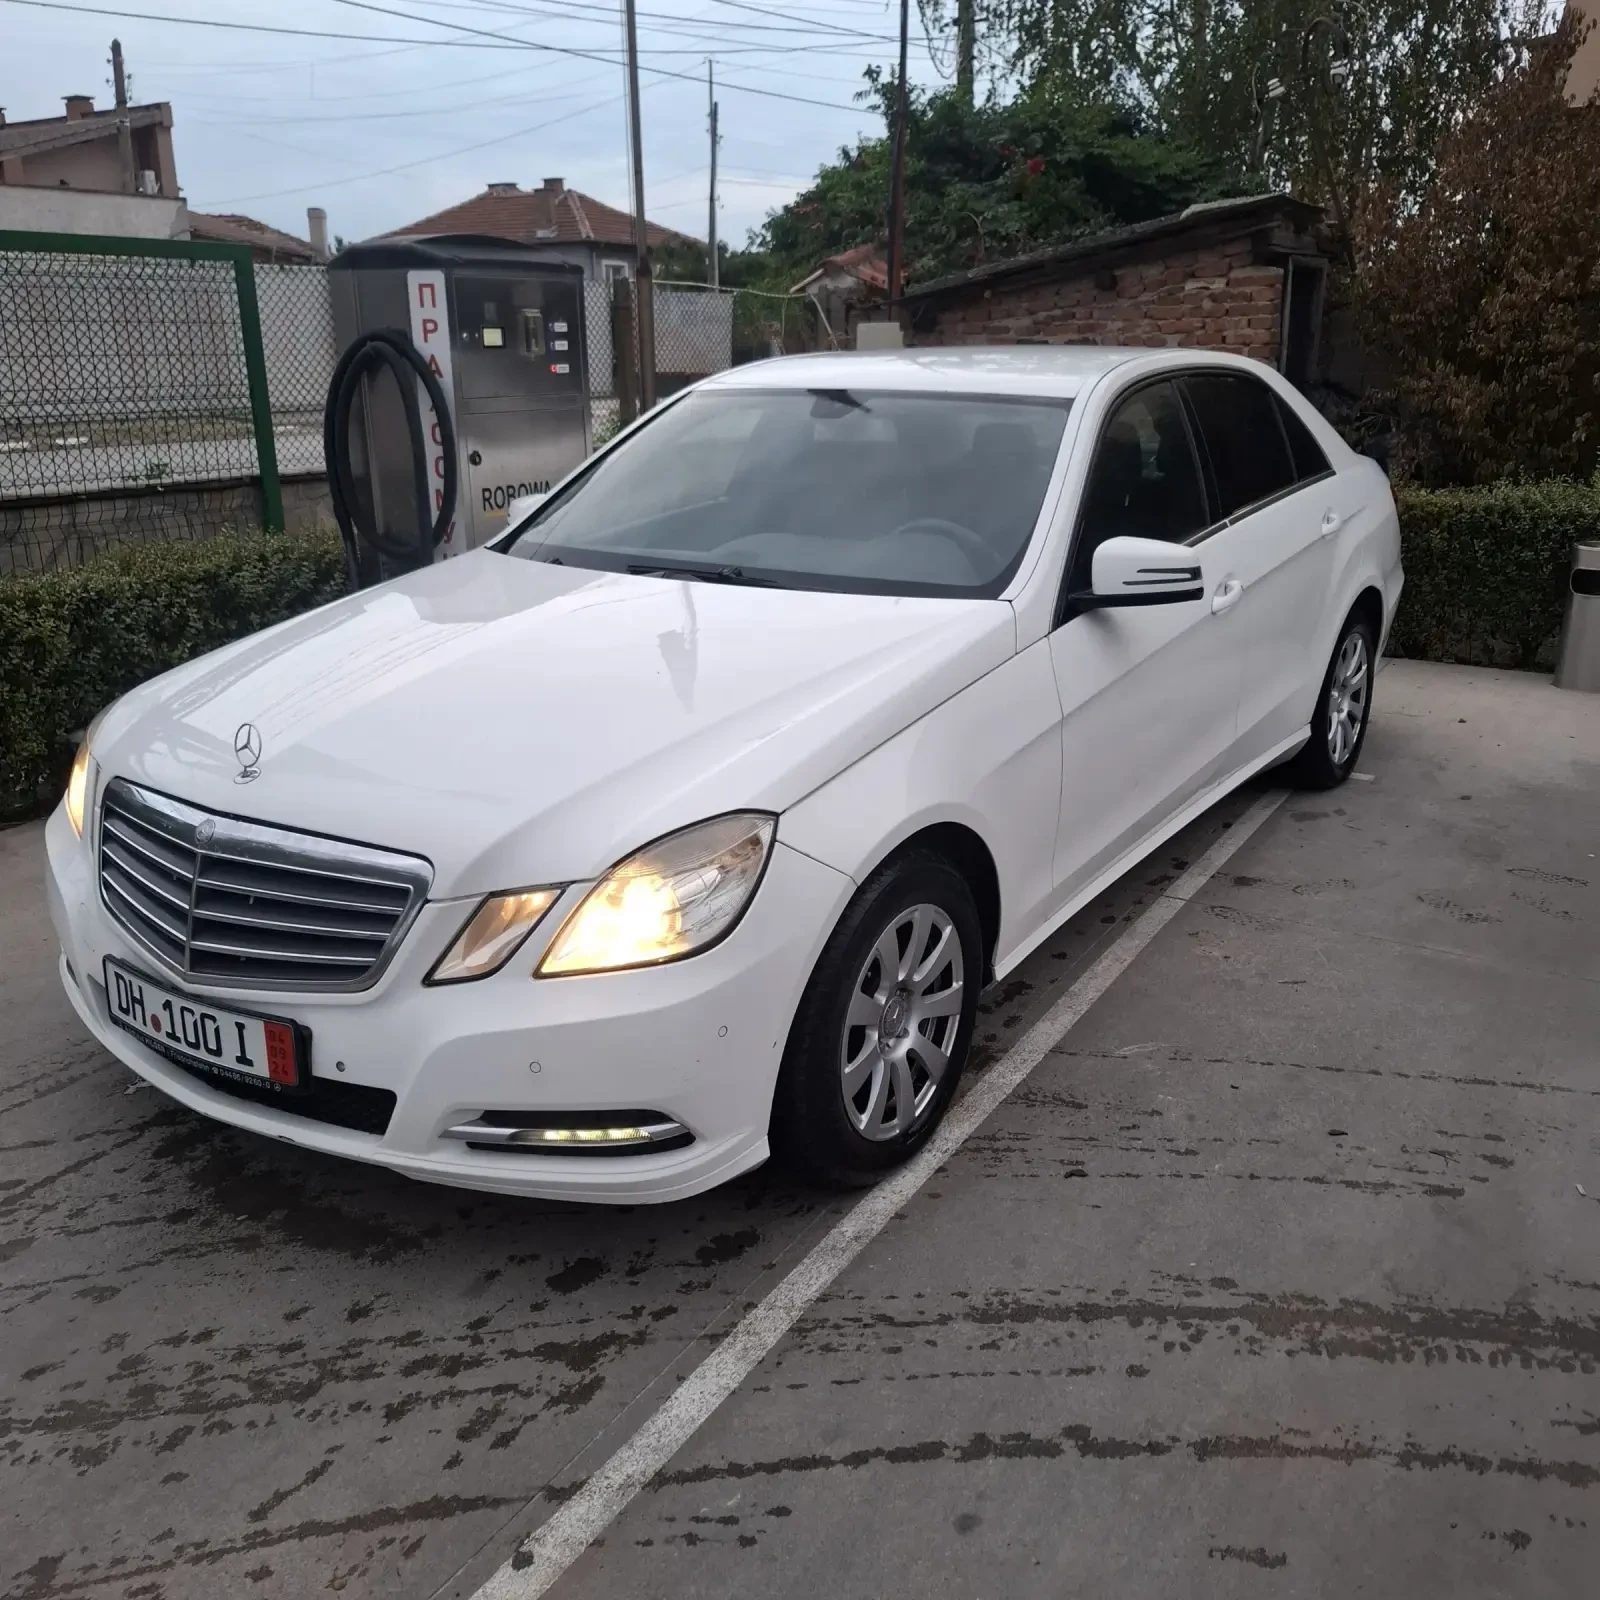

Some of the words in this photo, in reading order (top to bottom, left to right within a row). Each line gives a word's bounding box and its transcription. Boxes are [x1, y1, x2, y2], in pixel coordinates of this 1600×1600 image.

[114, 970, 147, 1028] DH
[162, 999, 222, 1058] 100
[271, 1060, 290, 1077] 24
